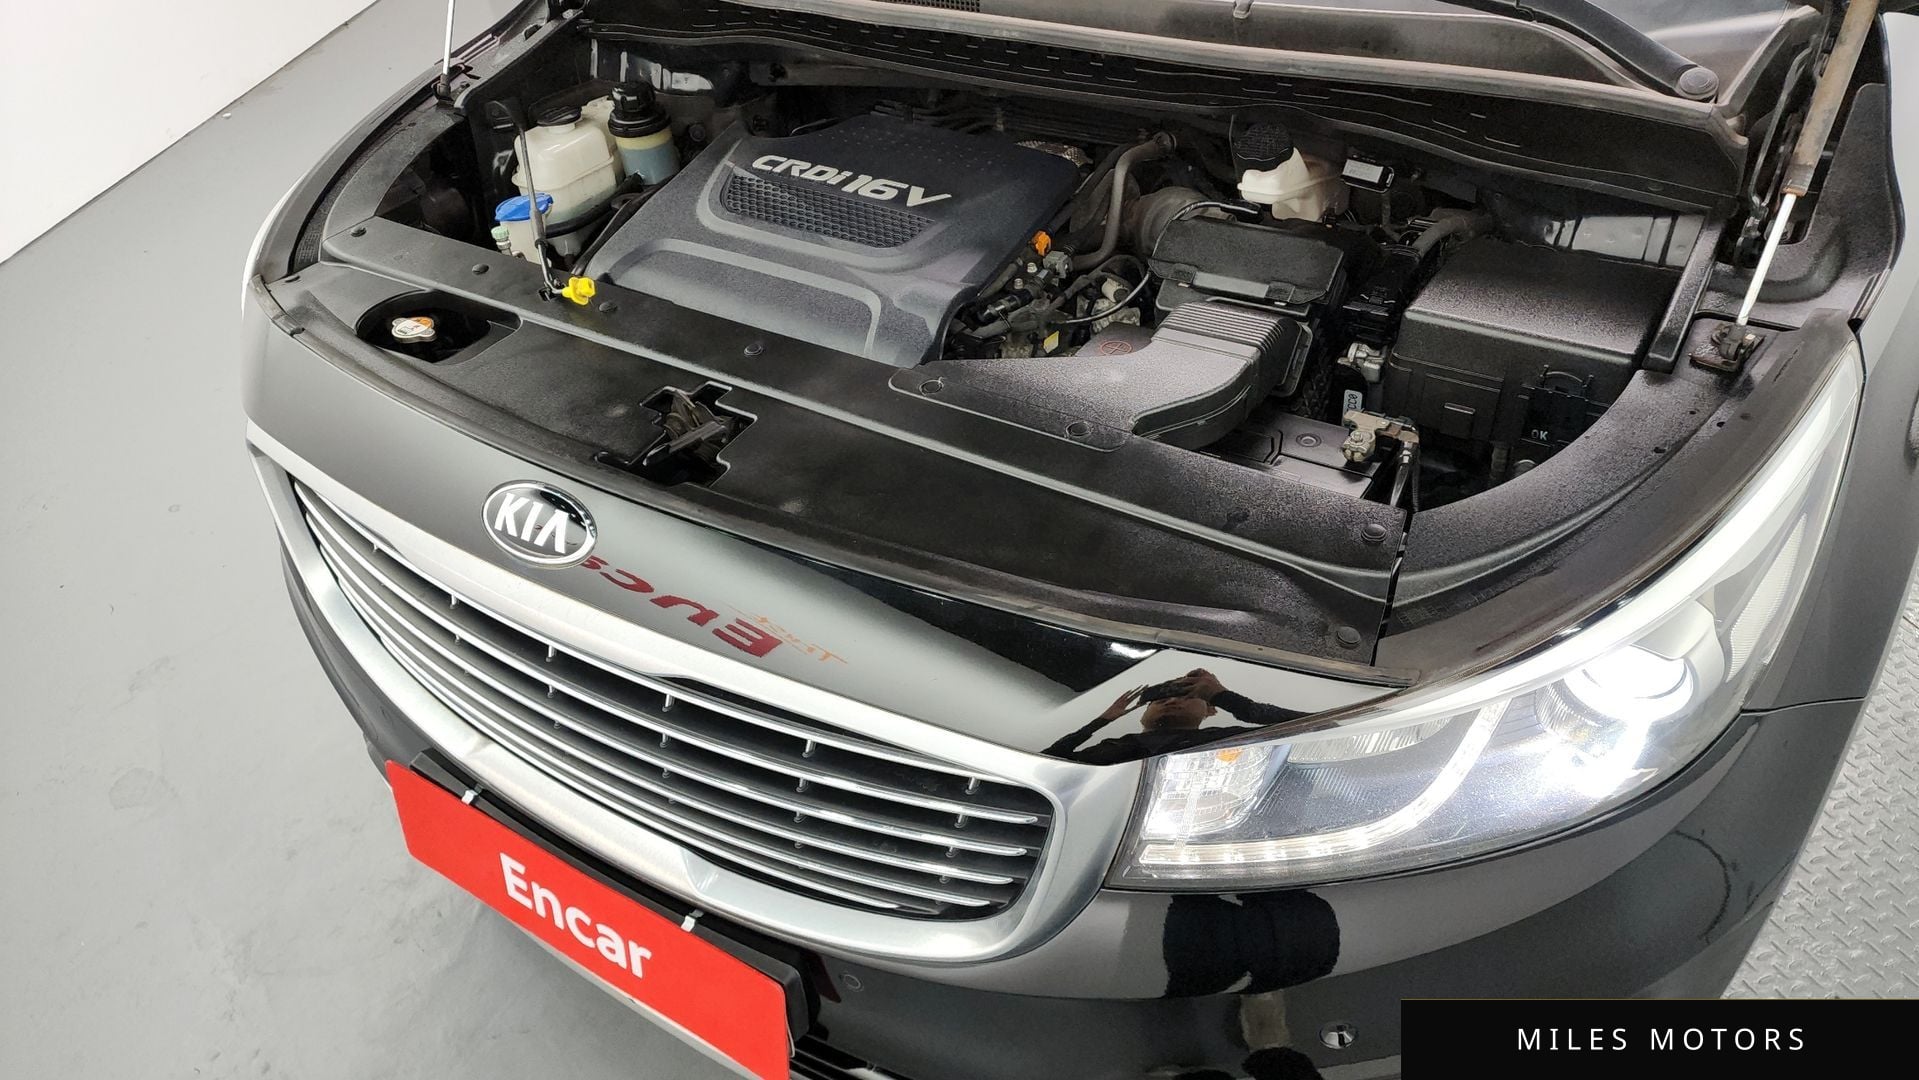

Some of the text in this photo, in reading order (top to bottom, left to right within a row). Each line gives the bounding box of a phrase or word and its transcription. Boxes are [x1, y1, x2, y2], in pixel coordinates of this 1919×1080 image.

[1531, 429, 1549, 441] OK
[494, 492, 569, 554] KIA
[499, 852, 652, 979] Encar
